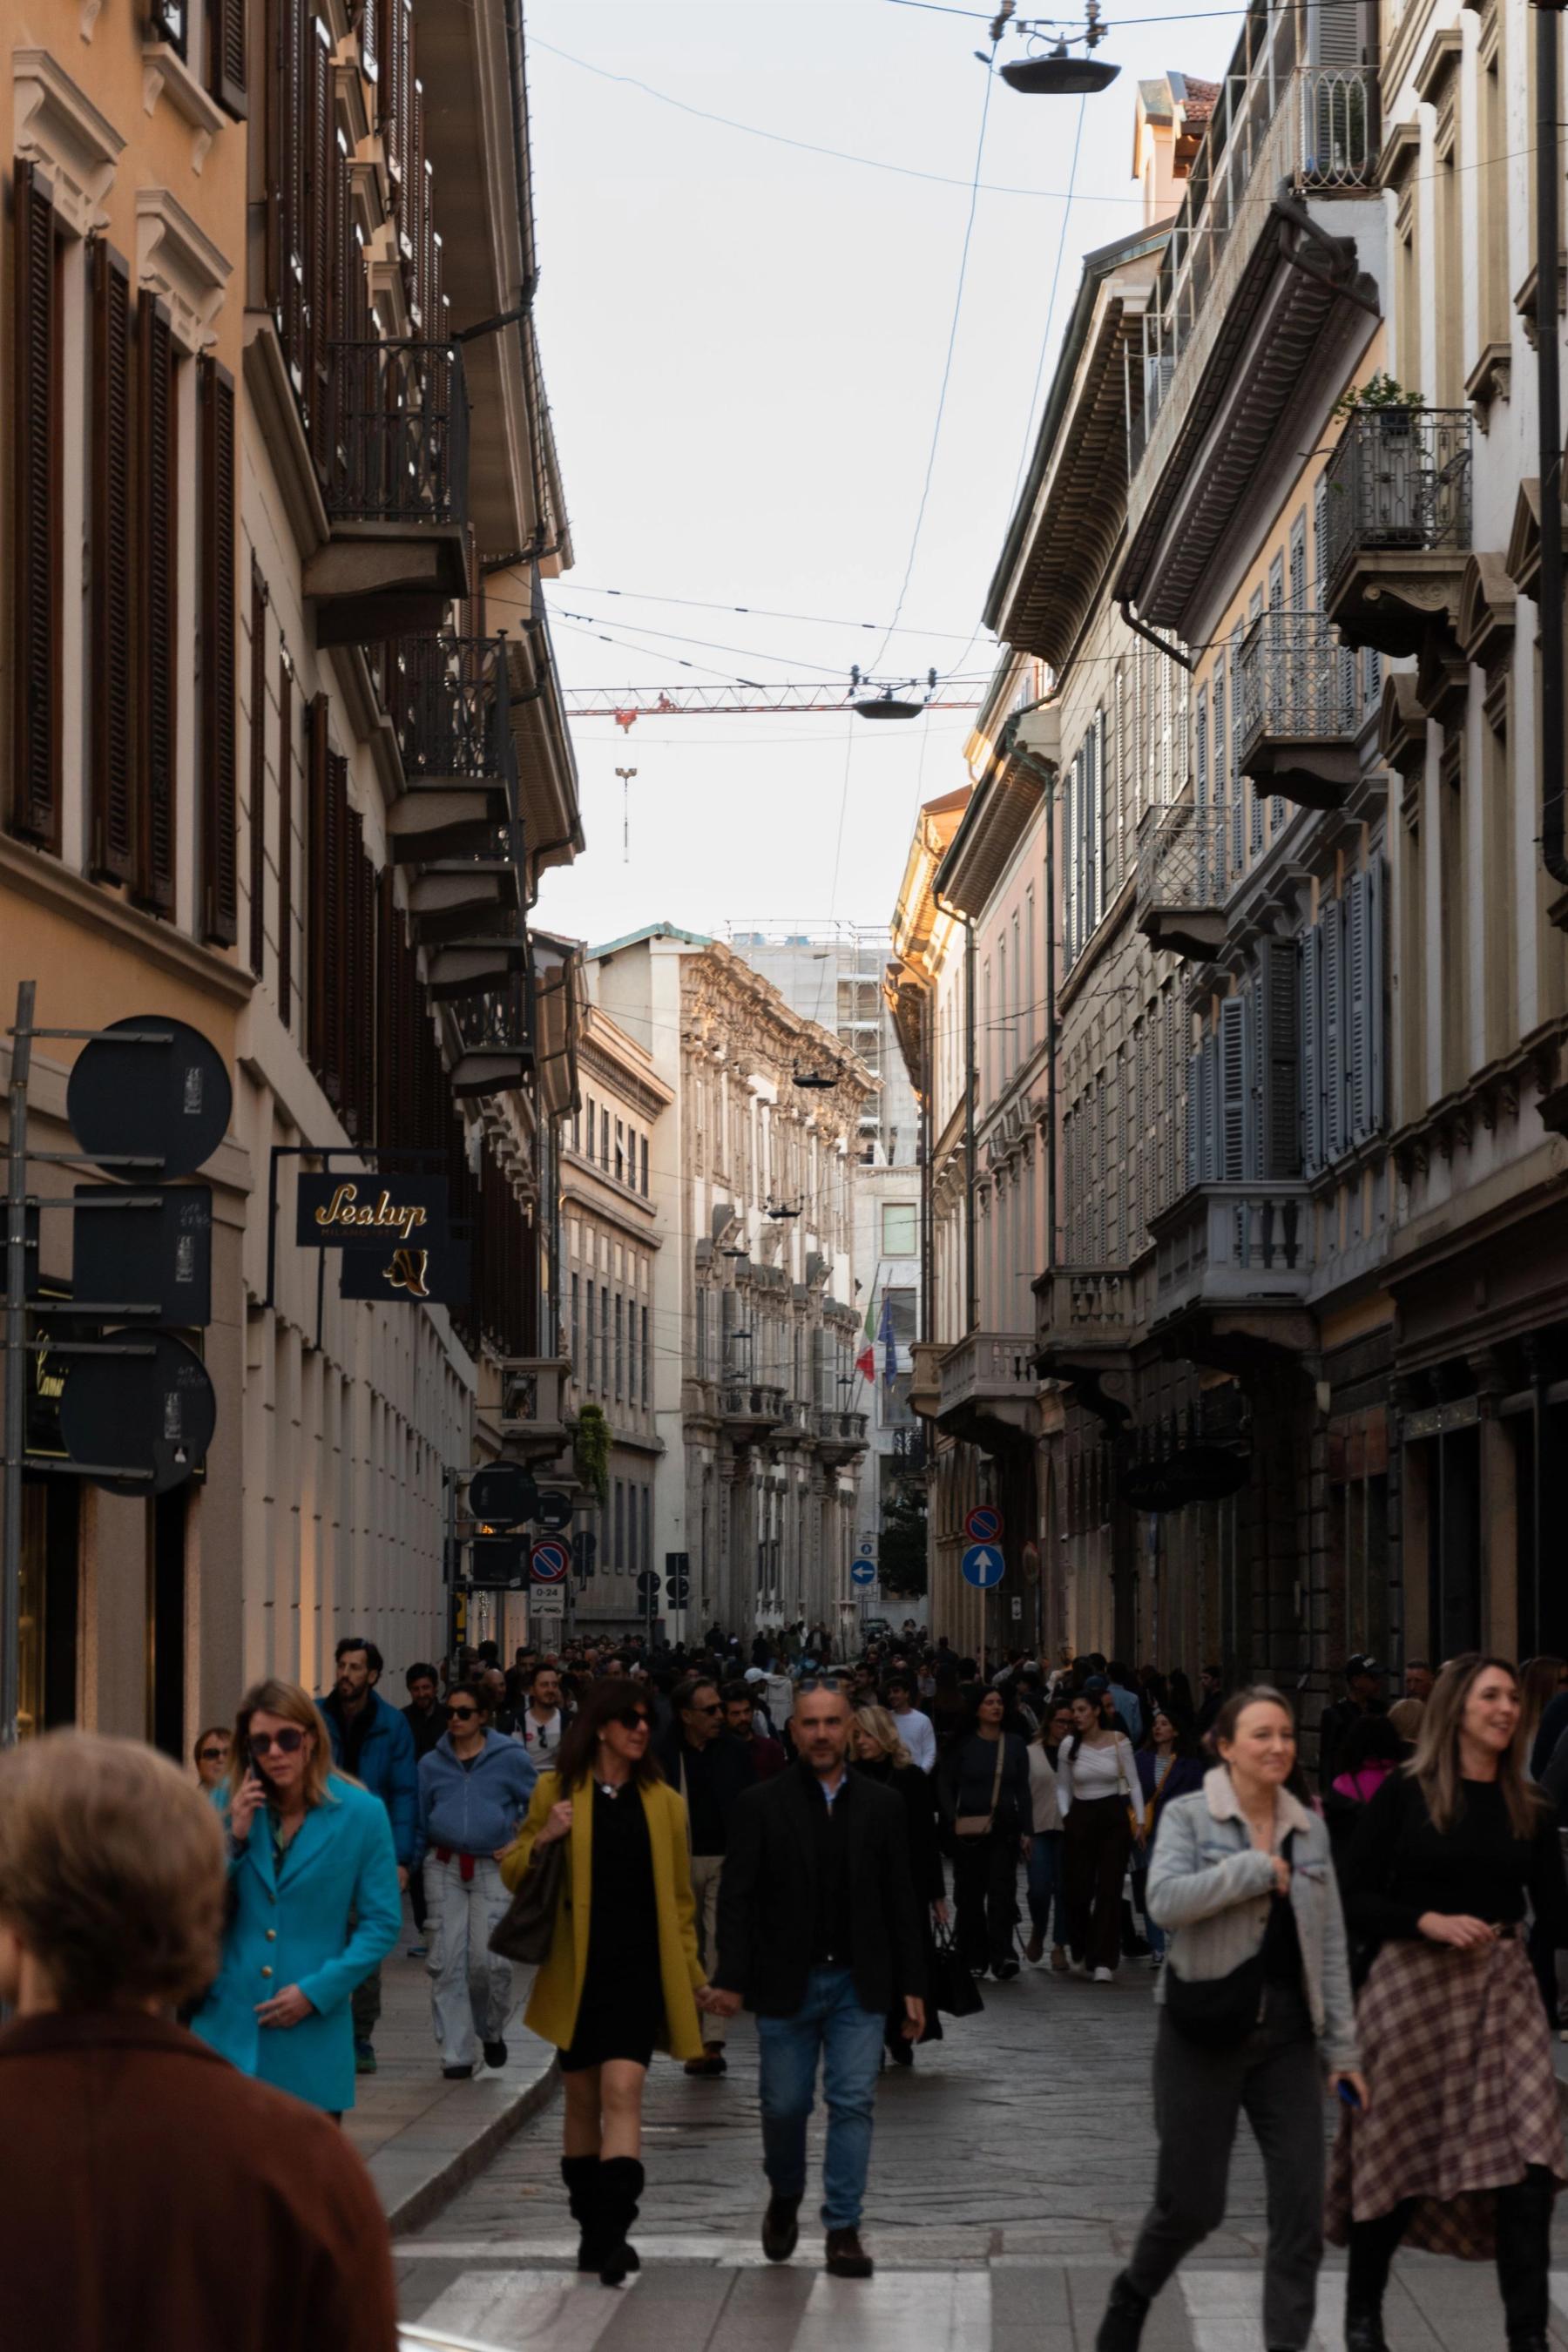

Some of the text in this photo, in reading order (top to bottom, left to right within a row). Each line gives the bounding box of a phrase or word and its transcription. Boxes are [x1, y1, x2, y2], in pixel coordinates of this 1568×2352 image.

[315, 1183, 427, 1239] Sealup
[321, 1227, 368, 1237] MILANO
[537, 1588, 558, 1597] 0-24
